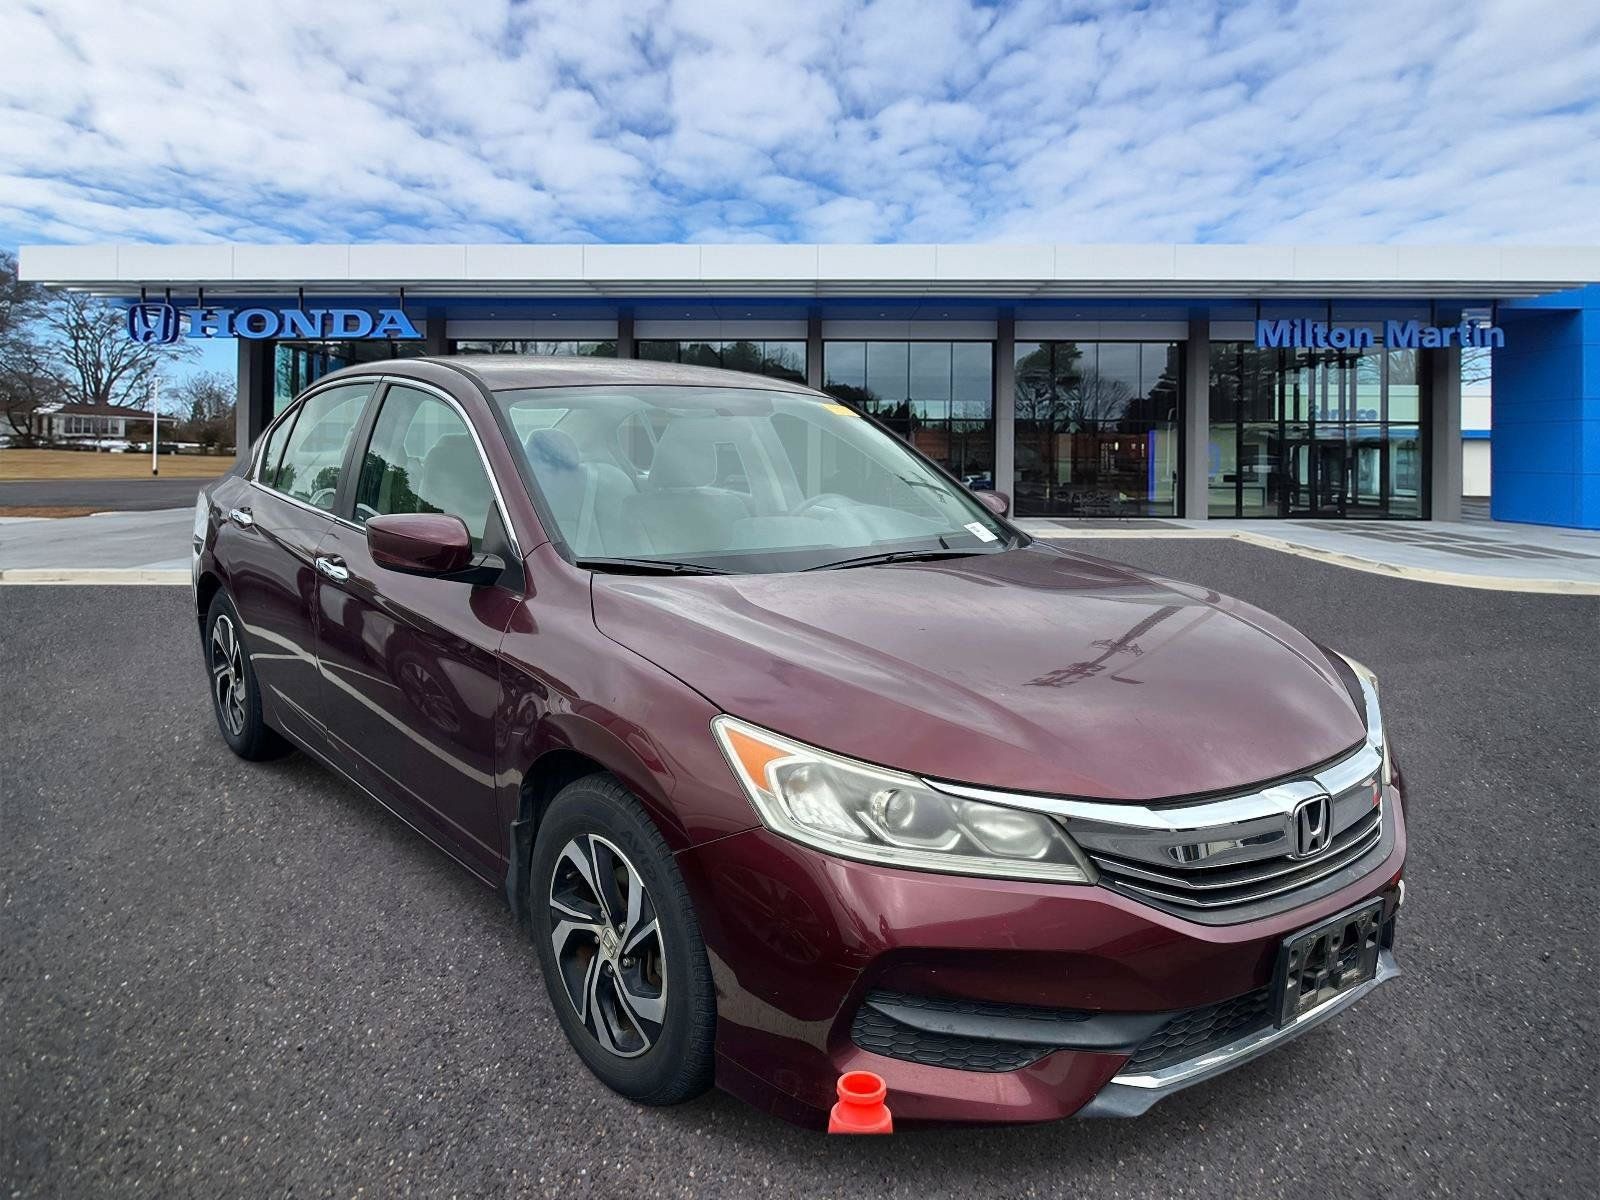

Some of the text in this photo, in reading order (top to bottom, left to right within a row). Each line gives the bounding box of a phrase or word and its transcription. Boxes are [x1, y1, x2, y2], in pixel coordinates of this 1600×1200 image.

[182, 309, 423, 339] HONDA
[1255, 319, 1505, 348] Milton Martin
